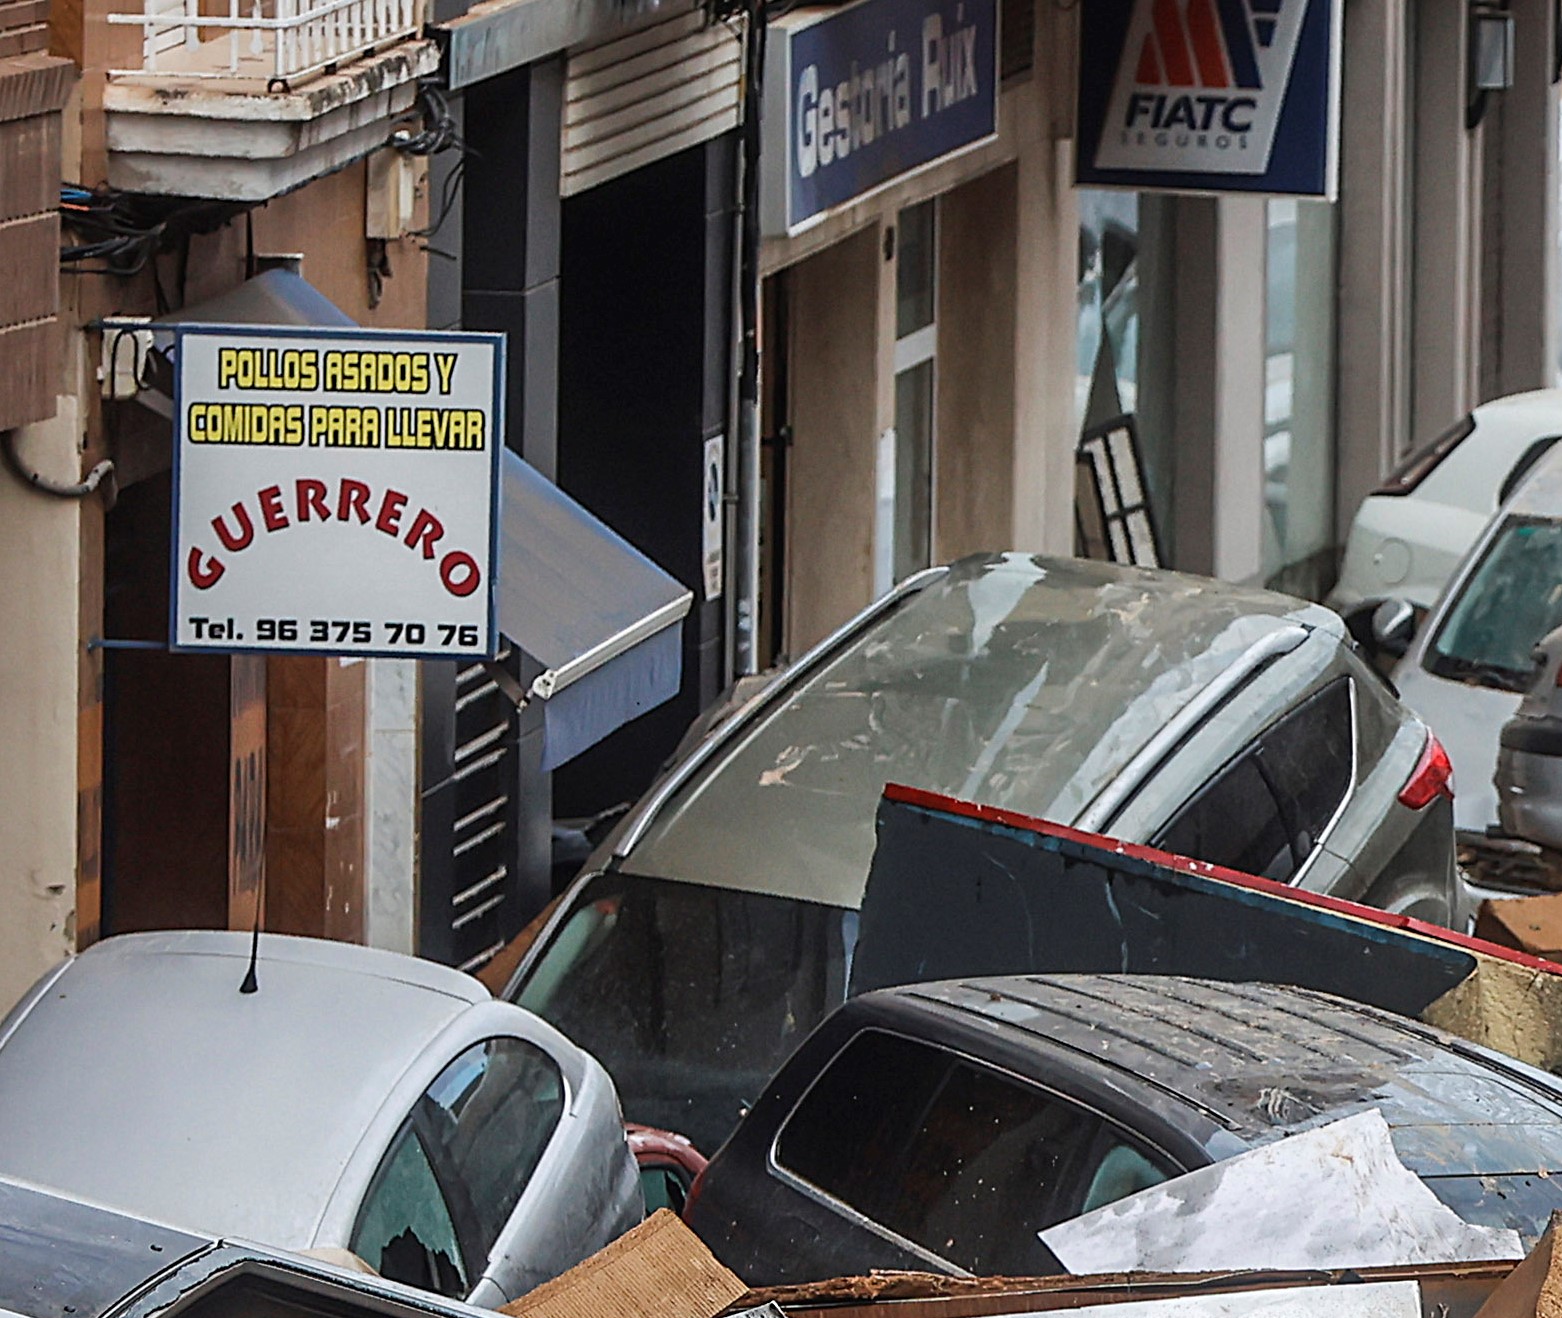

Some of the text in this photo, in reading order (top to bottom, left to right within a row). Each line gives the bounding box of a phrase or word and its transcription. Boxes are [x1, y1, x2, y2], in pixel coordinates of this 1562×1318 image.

[1124, 93, 1257, 133] FIATC
[1120, 130, 1248, 149] SEGUROS
[218, 347, 458, 395] POLLOS ASADOS Y
[188, 402, 485, 451] COMIDAS PARA LLEVAR
[187, 478, 481, 597] GUERRERO
[189, 617, 479, 646] Tel. 96 375 70 76
